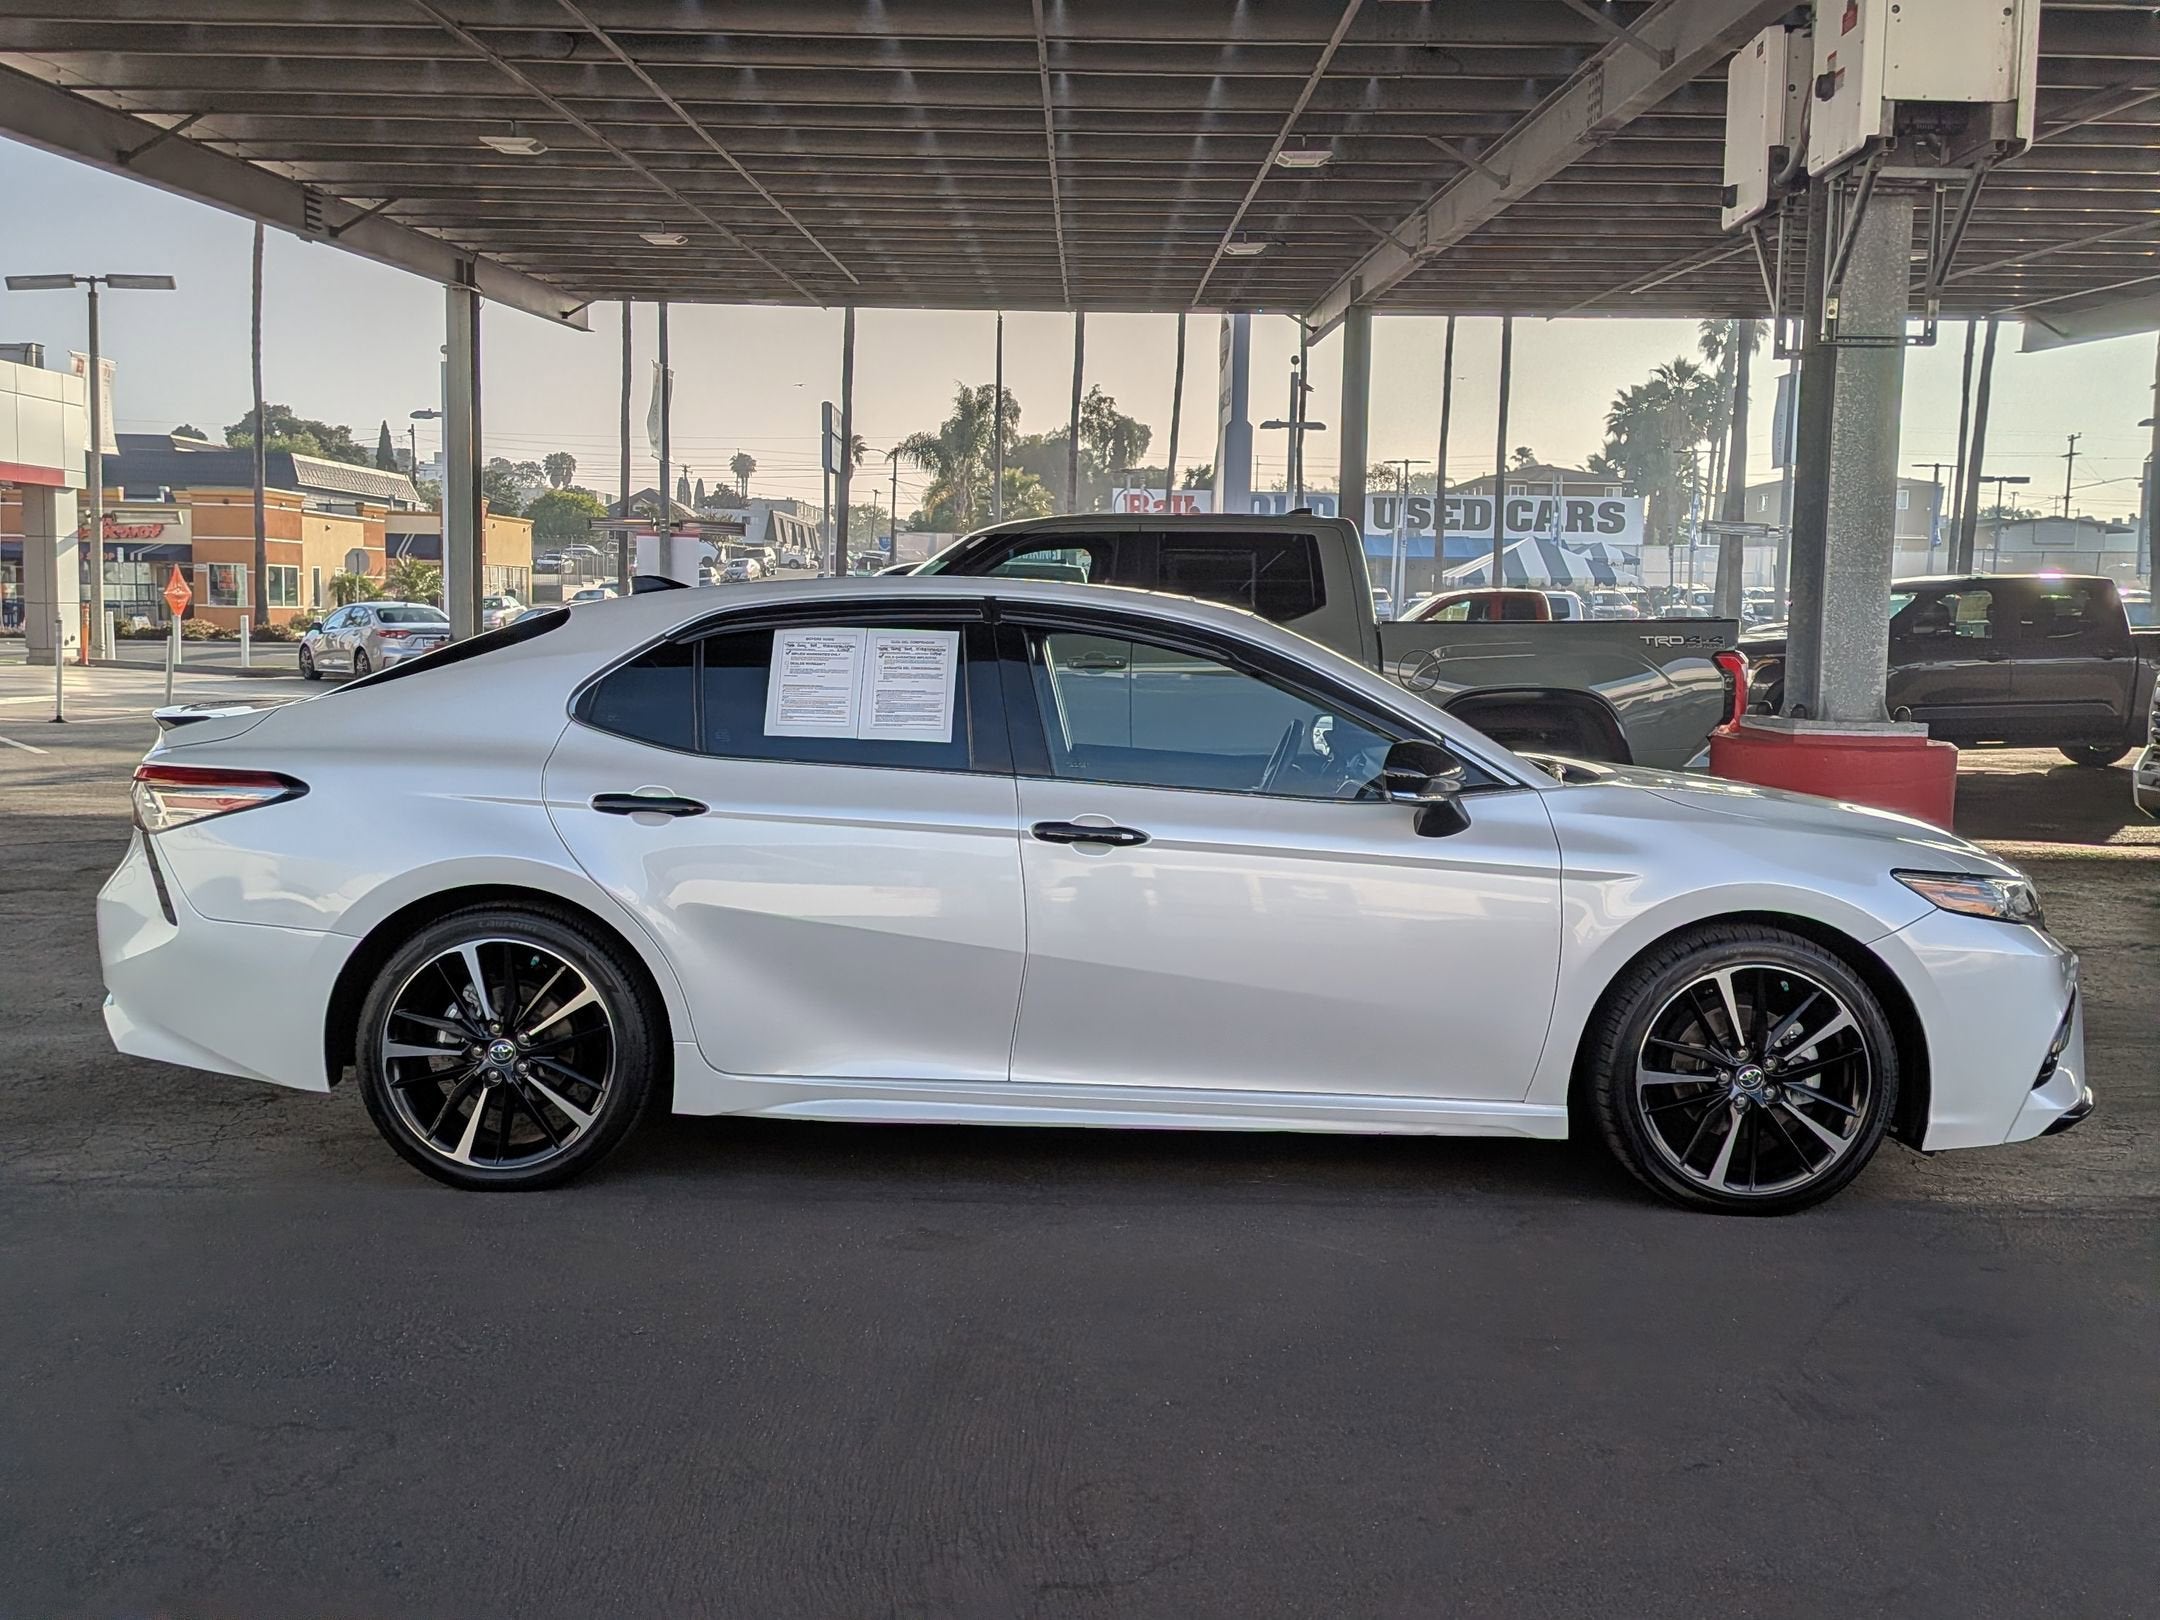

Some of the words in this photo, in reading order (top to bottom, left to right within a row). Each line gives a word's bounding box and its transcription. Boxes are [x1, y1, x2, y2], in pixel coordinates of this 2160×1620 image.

[1372, 497, 1492, 531] USED
[1505, 499, 1626, 534] CARS
[1640, 635, 1685, 648] TRD
